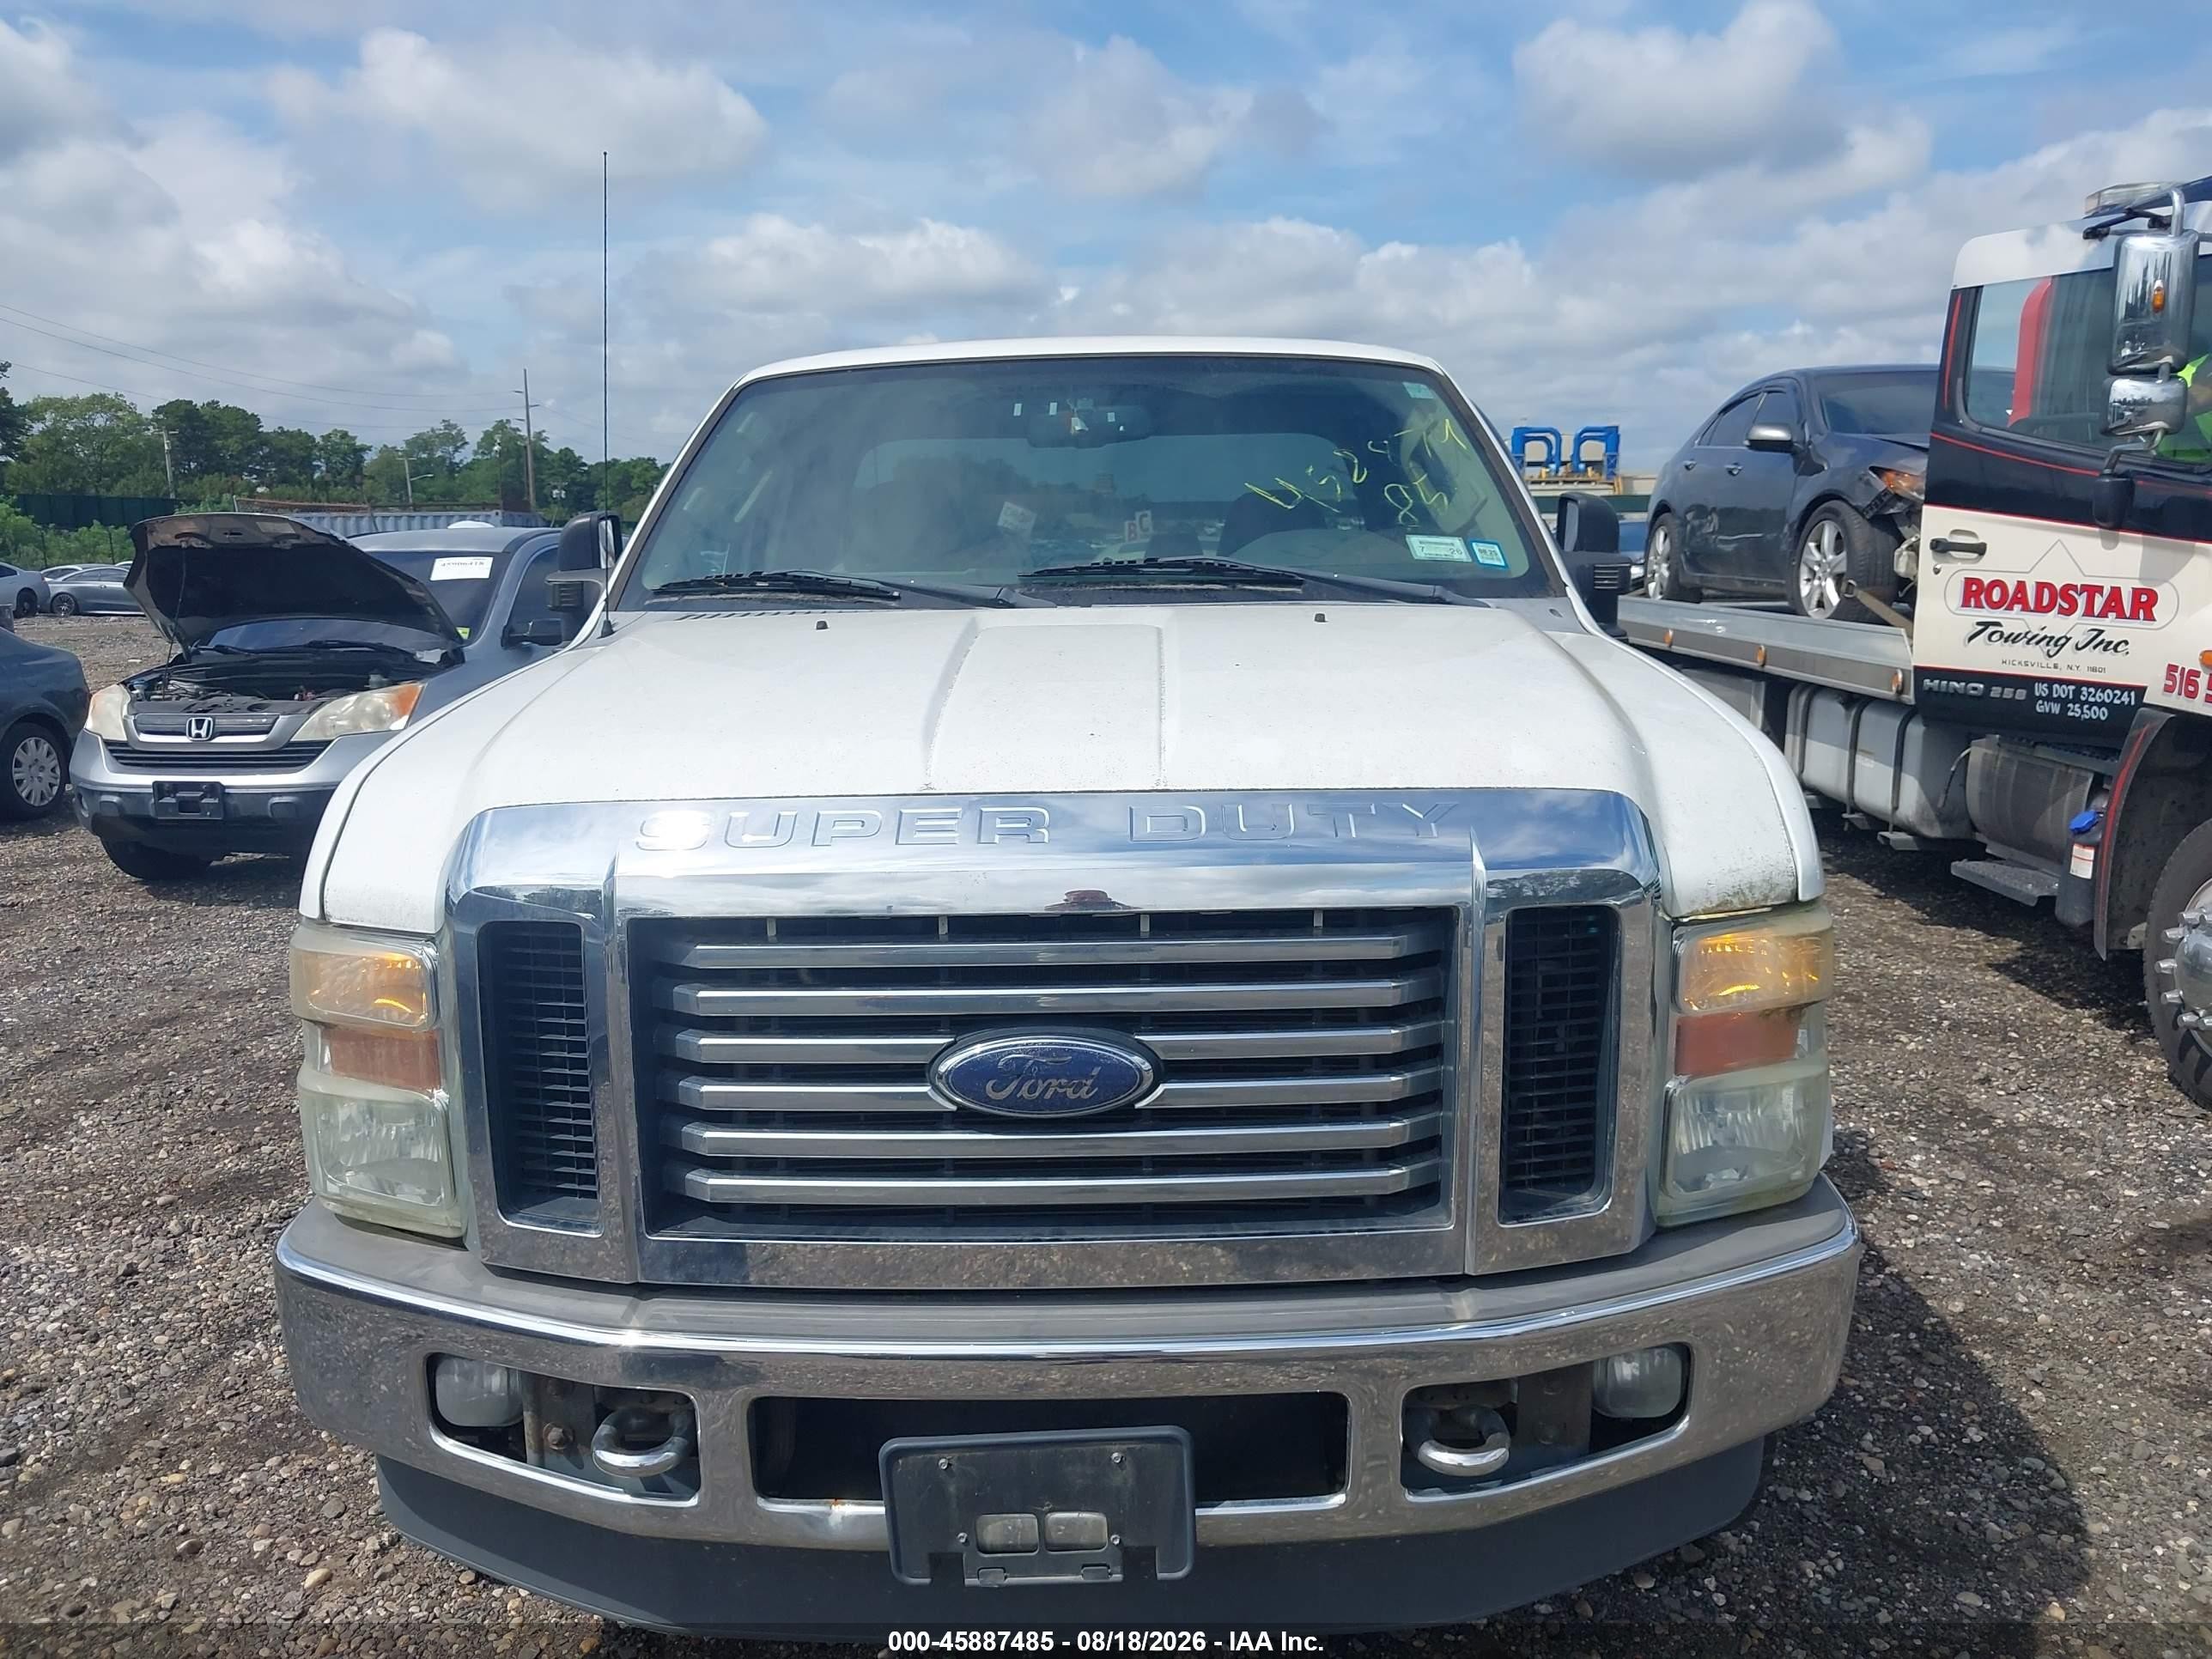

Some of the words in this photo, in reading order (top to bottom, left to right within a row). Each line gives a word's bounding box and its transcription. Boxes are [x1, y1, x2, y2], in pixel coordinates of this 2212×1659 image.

[1960, 577, 2159, 622] ROADSTAR
[1967, 621, 2073, 659] Towing
[2075, 628, 2130, 656] Inc.
[2002, 659, 2063, 671] HICKSVILLE,
[2163, 663, 2202, 700] 516
[1923, 678, 1984, 696] HINO
[2034, 682, 2049, 697] US
[2052, 684, 2076, 700] DOT
[2080, 686, 2136, 706] 3260241
[2035, 699, 2061, 714] GVW
[2067, 702, 2108, 721] 25,500
[635, 805, 1050, 852] SUPER
[1128, 802, 1460, 842] DUTY
[986, 1053, 1102, 1100] Ford
